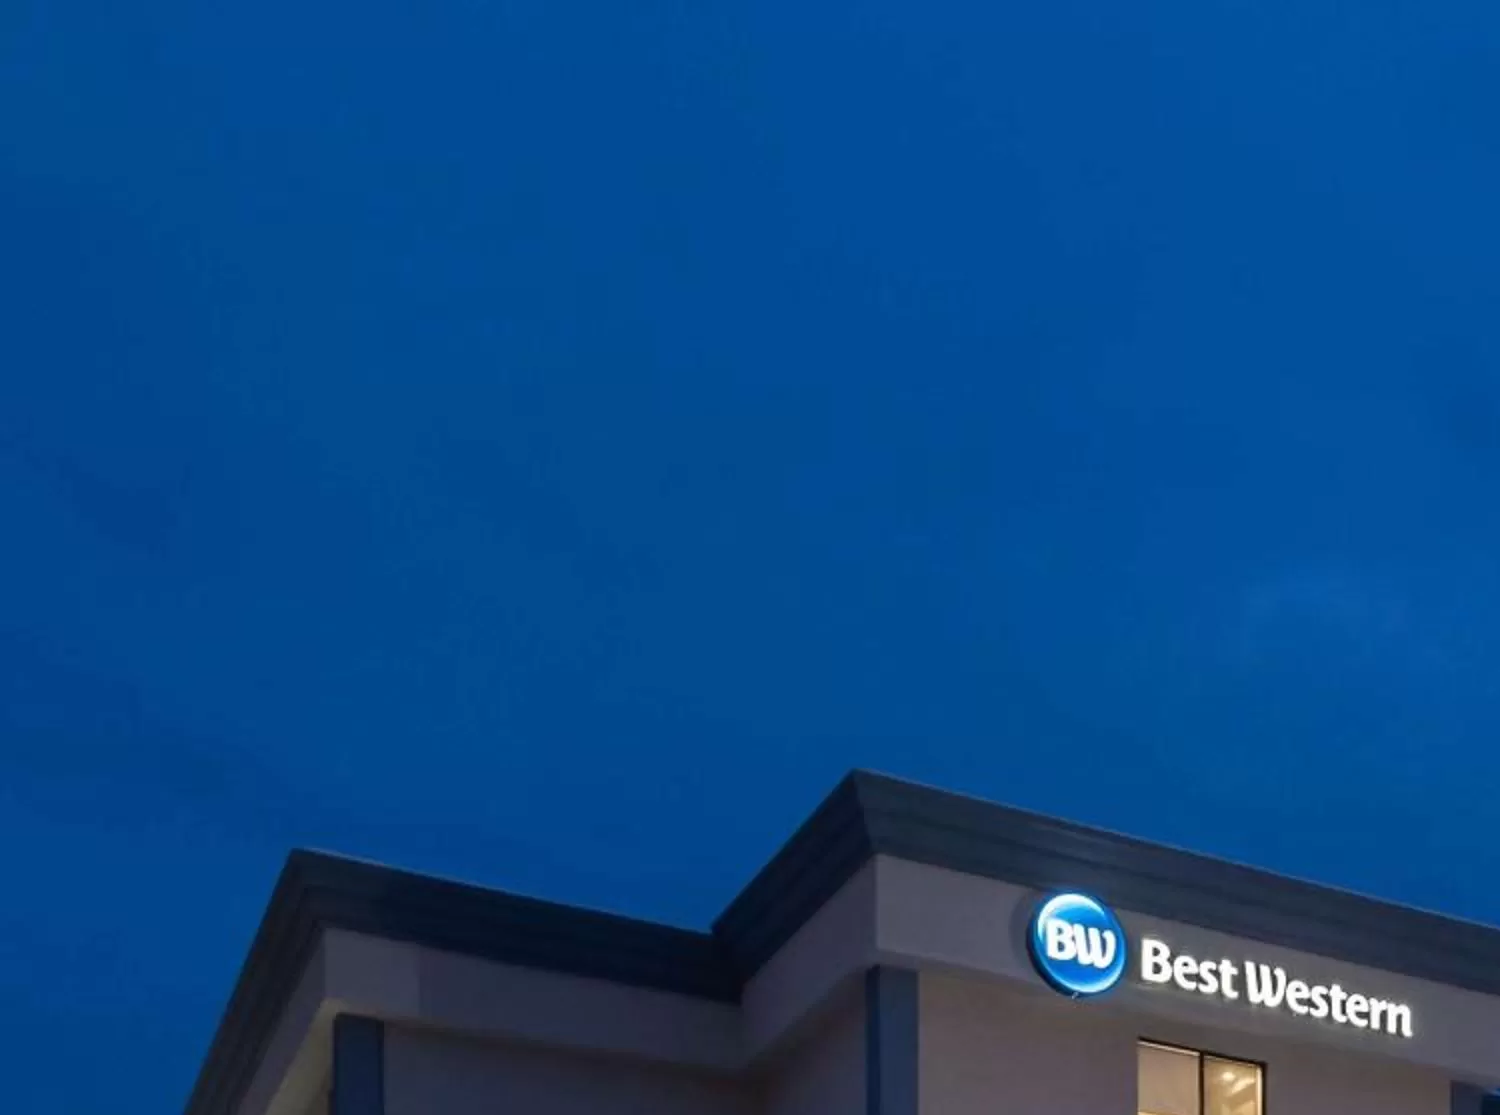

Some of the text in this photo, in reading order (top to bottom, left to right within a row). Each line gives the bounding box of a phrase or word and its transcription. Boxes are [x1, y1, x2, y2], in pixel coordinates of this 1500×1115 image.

[1046, 918, 1116, 969] BW
[1140, 938, 1413, 1037] Best Western
